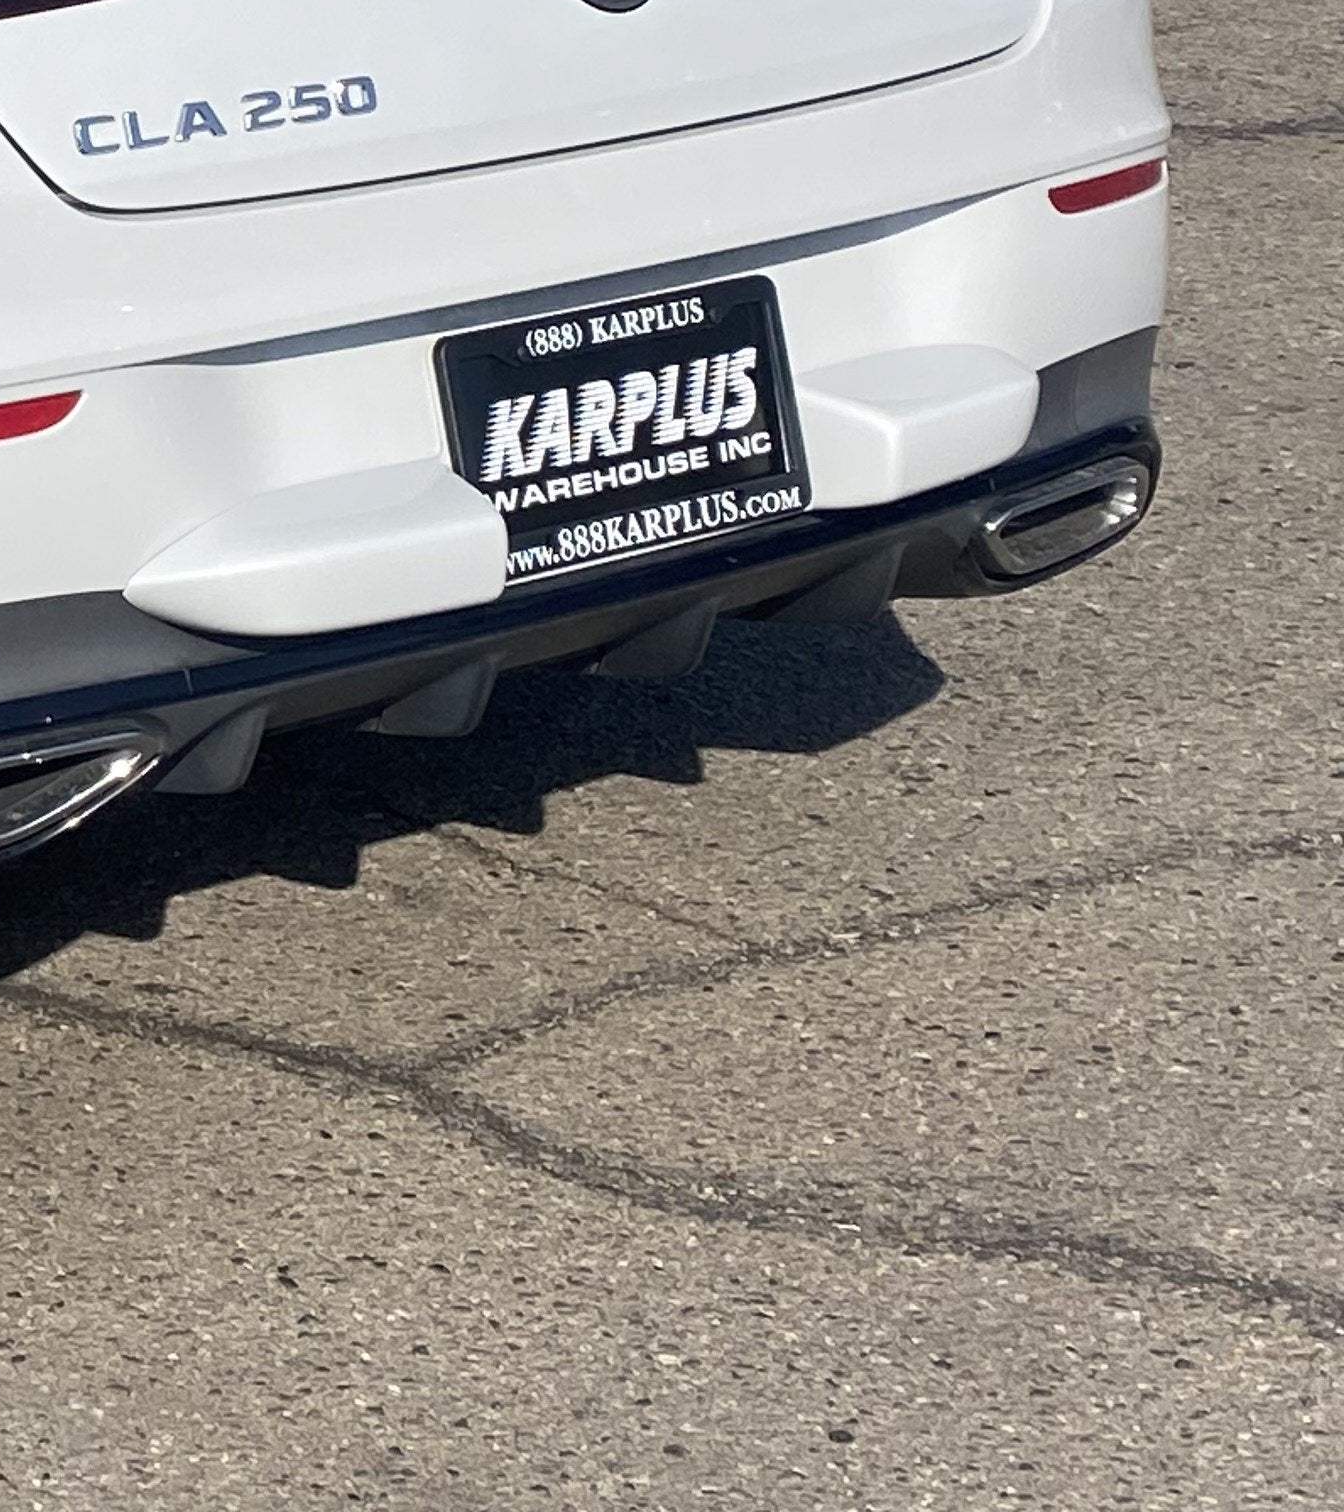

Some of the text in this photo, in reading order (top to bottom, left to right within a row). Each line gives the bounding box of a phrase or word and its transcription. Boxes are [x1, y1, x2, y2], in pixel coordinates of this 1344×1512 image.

[73, 76, 378, 155] CLA 250
[525, 296, 705, 357] (888) KARPLUS
[478, 346, 758, 483] KARPLUS
[718, 431, 772, 463] INC
